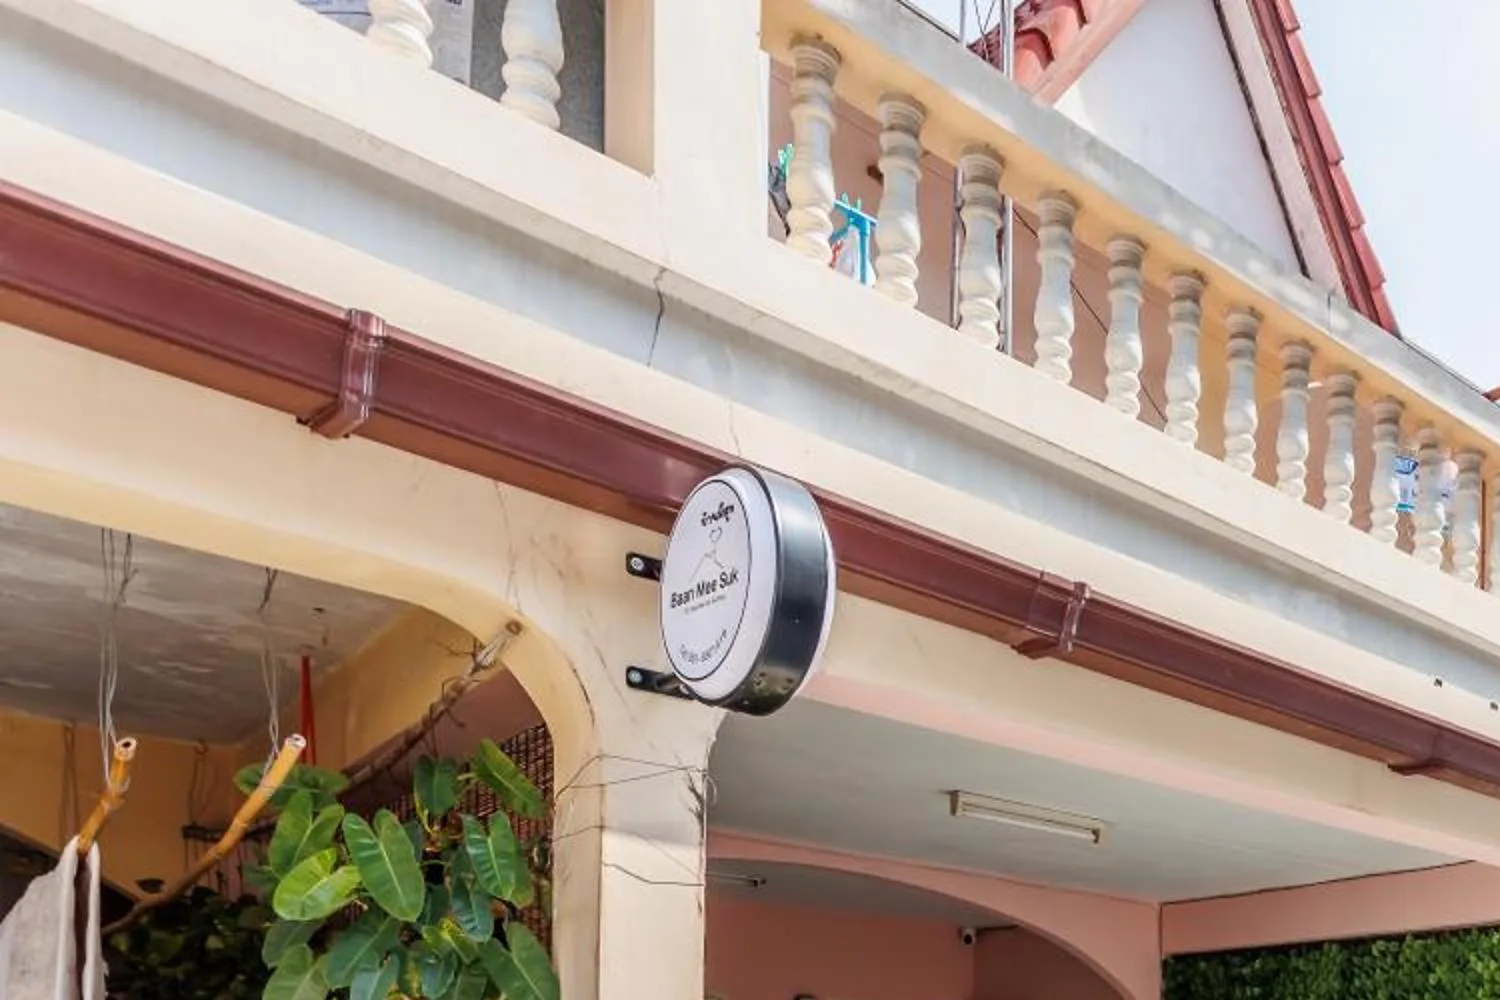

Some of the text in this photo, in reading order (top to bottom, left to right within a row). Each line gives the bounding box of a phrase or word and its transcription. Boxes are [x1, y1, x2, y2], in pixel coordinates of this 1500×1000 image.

[671, 588, 695, 609] Baan
[696, 579, 717, 599] Mee
[719, 567, 739, 589] Suk
